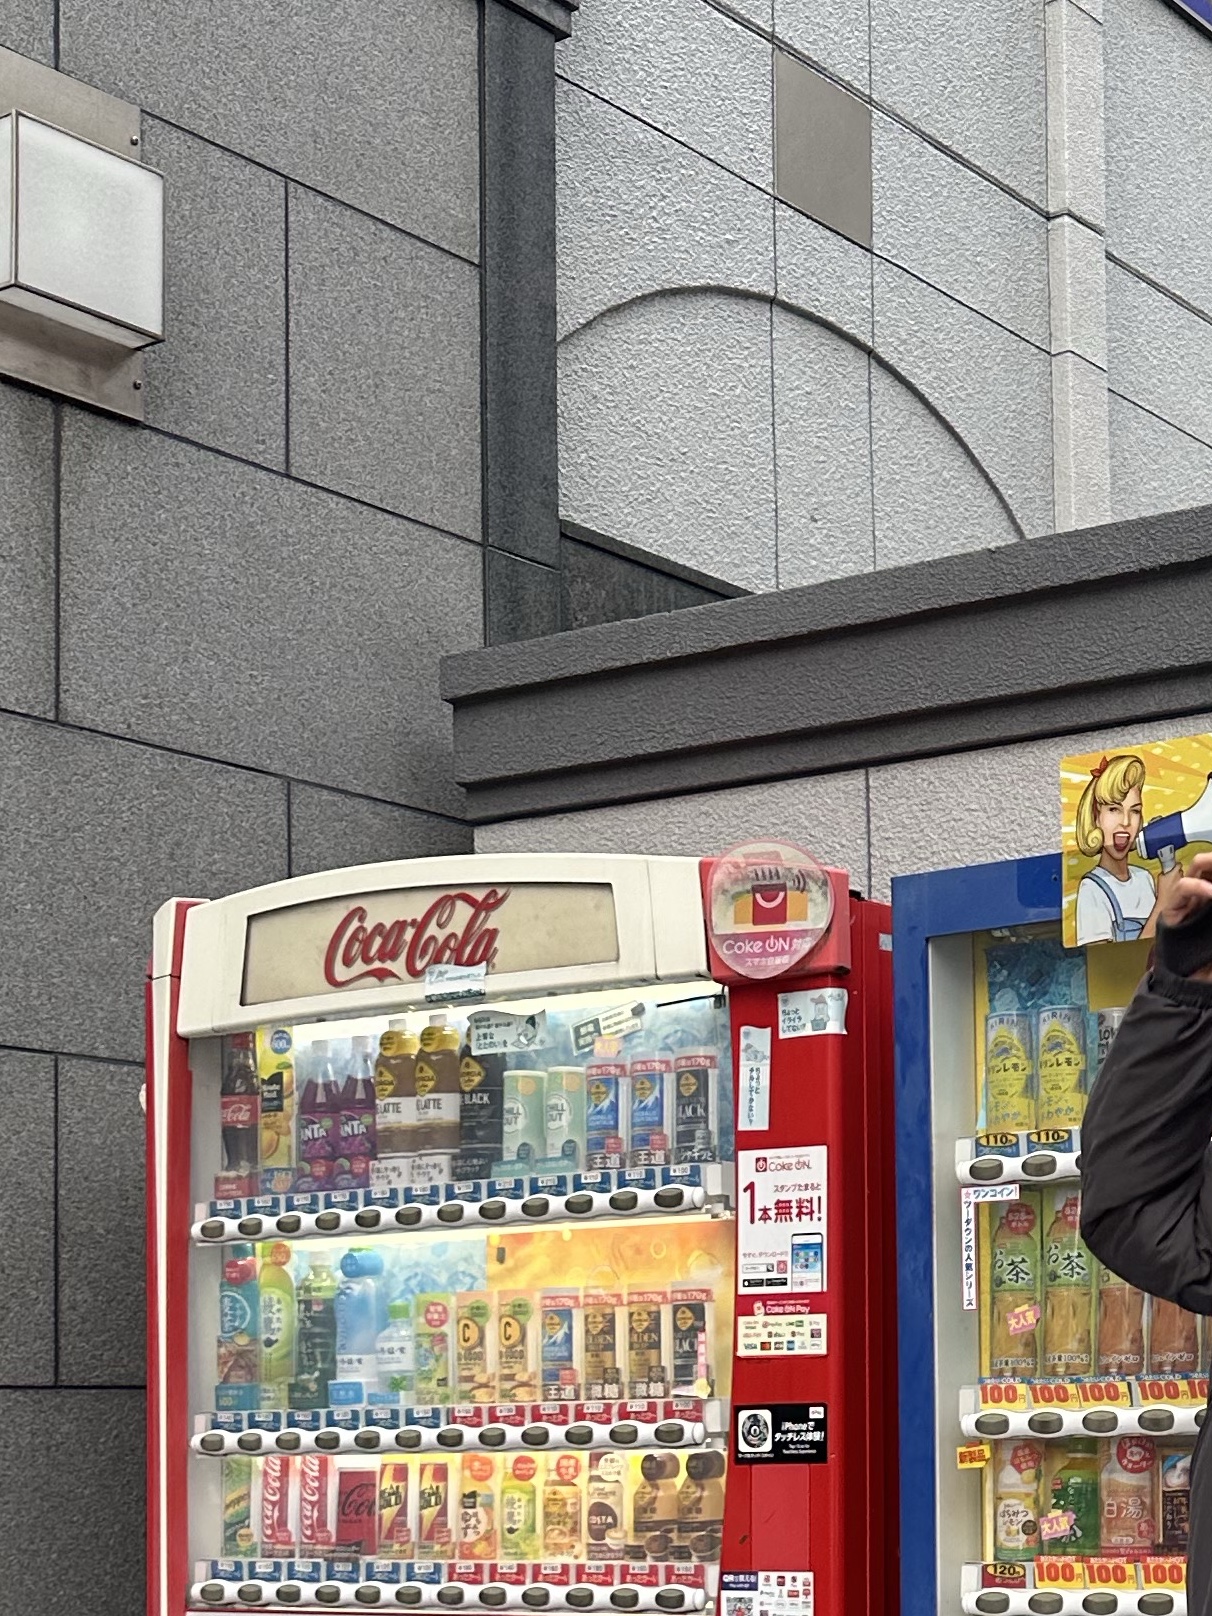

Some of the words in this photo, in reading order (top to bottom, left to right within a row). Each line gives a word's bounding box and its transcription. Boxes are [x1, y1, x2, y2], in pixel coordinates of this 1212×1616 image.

[723, 936, 763, 955] Coke
[765, 933, 790, 953] ON
[1043, 1011, 1071, 1023] KIRIN
[768, 1160, 793, 1173] Coke
[1008, 1309, 1037, 1330] 大人気
[1104, 1498, 1144, 1519] 白湯
[1041, 1516, 1070, 1532] 大人気
